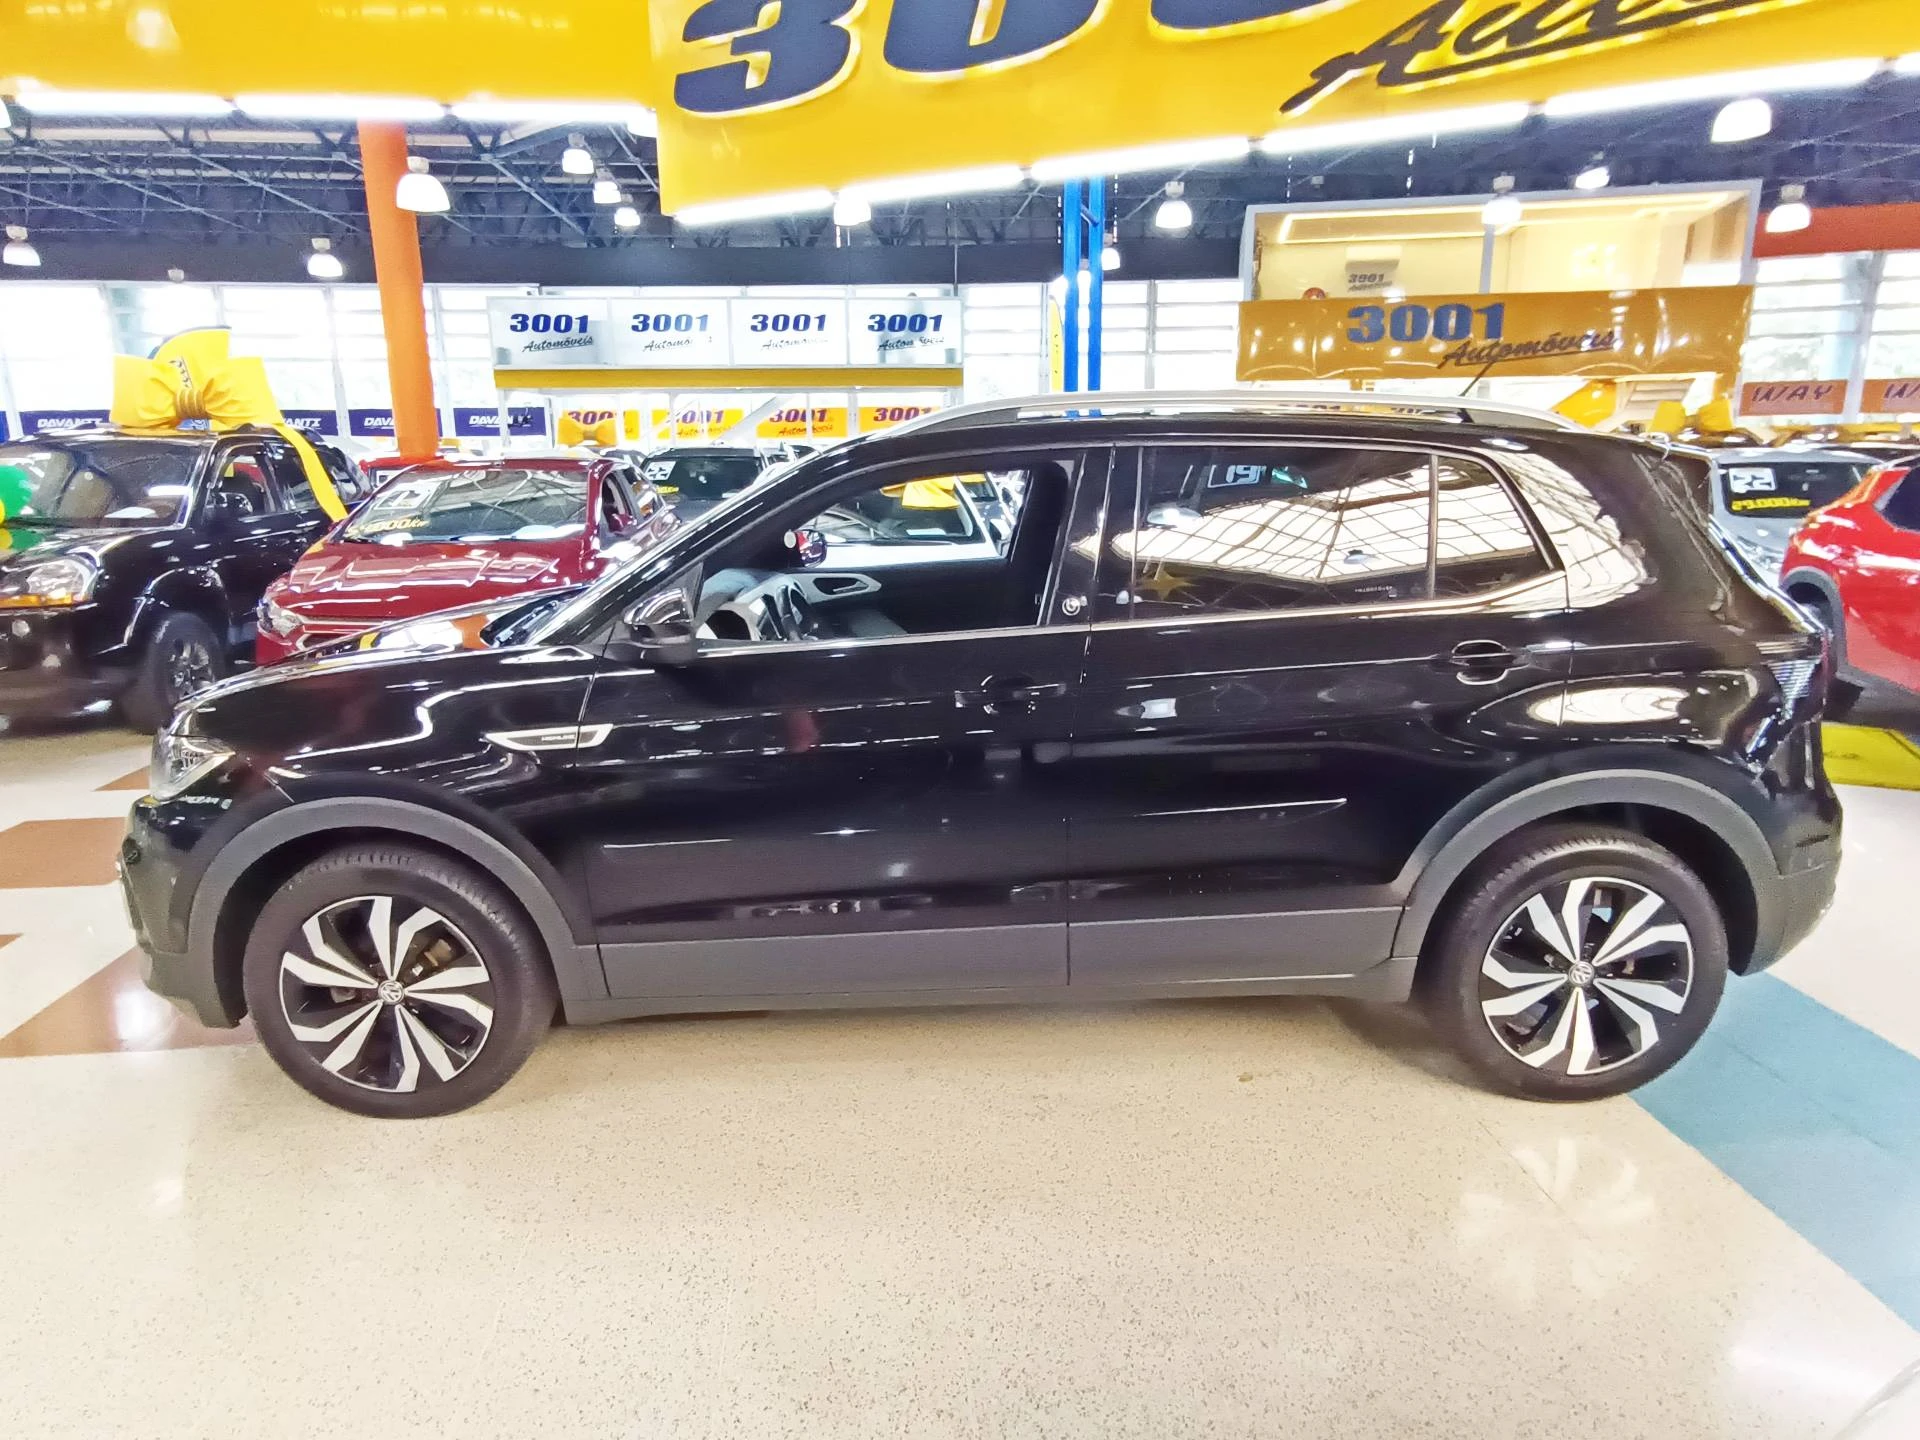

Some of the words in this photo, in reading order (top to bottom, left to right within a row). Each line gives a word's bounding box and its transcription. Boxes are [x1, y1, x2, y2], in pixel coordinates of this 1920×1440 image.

[510, 313, 589, 333] 3001
[631, 313, 709, 332] 3001
[750, 314, 827, 332] 3001
[868, 314, 943, 332] 3001
[1347, 302, 1505, 343] 3001
[1752, 385, 1833, 401] WAY
